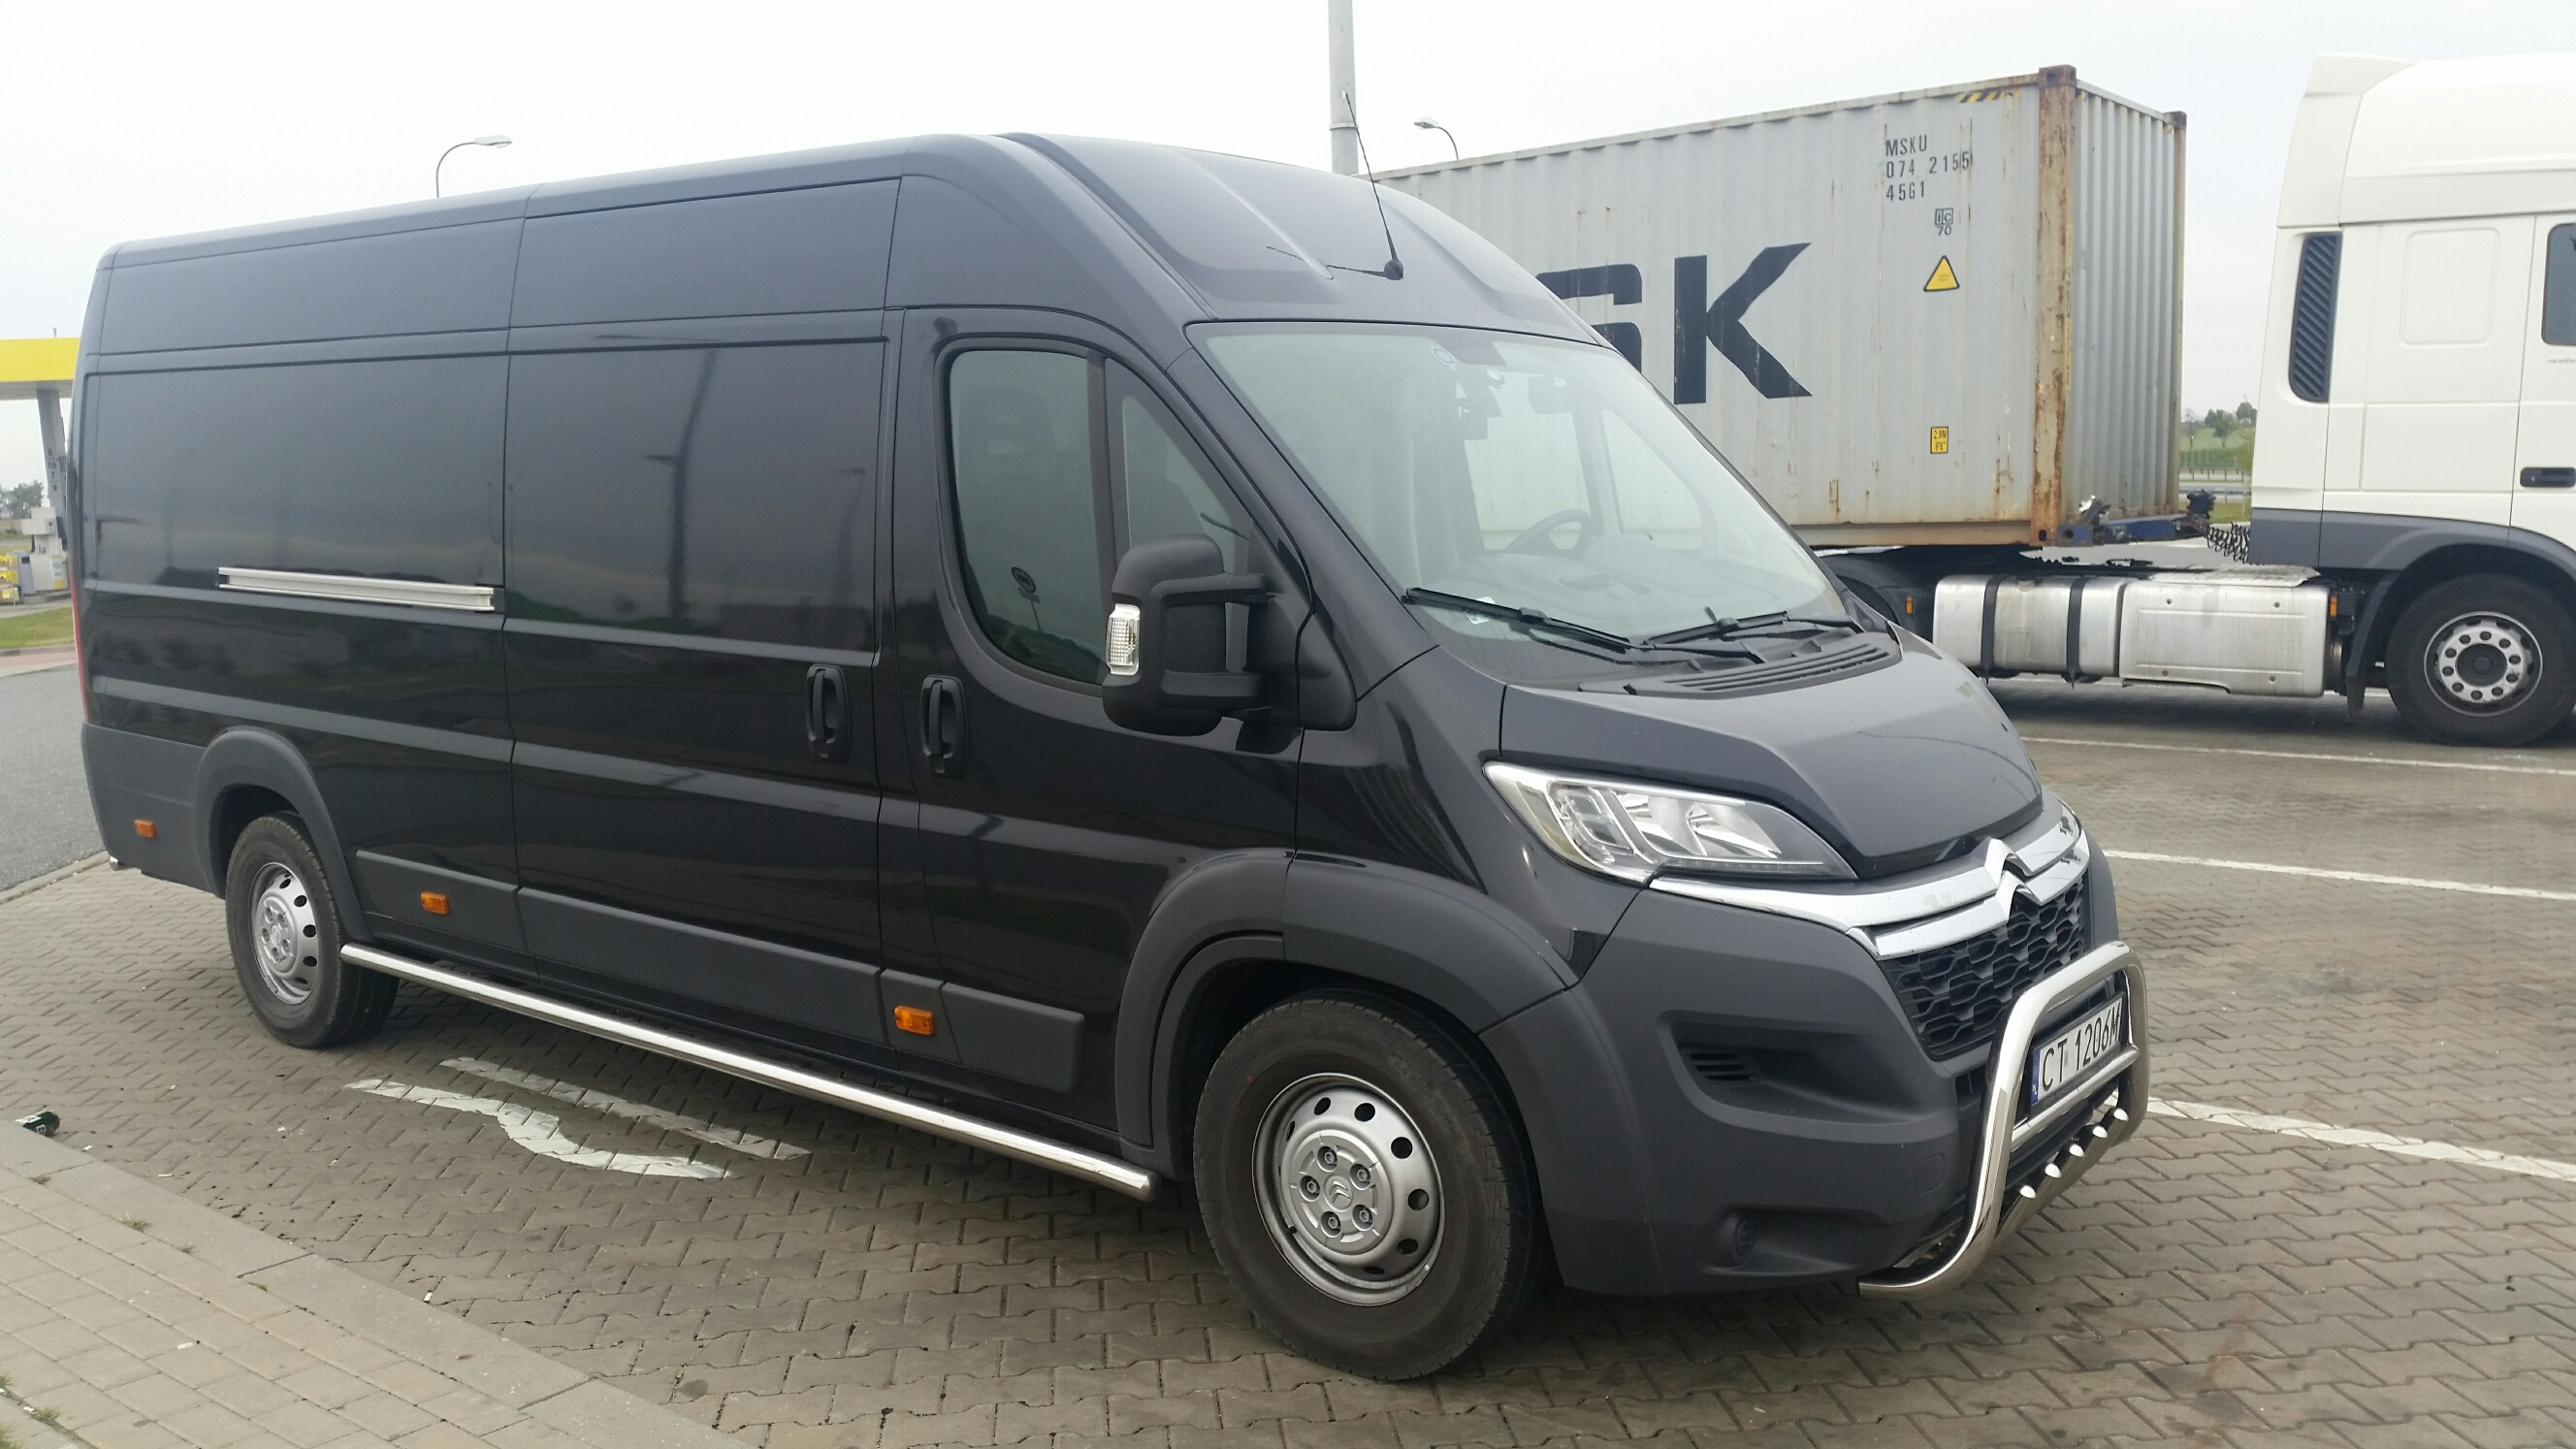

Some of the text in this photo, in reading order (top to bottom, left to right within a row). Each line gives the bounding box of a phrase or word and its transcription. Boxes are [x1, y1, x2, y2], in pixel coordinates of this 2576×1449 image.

[1885, 135, 1928, 156] MSKU
[1886, 150, 1972, 178] 074 2155
[1937, 225, 1952, 236] 70
[2042, 1038, 2068, 1092] CT
[2075, 1003, 2120, 1071] 1206M
